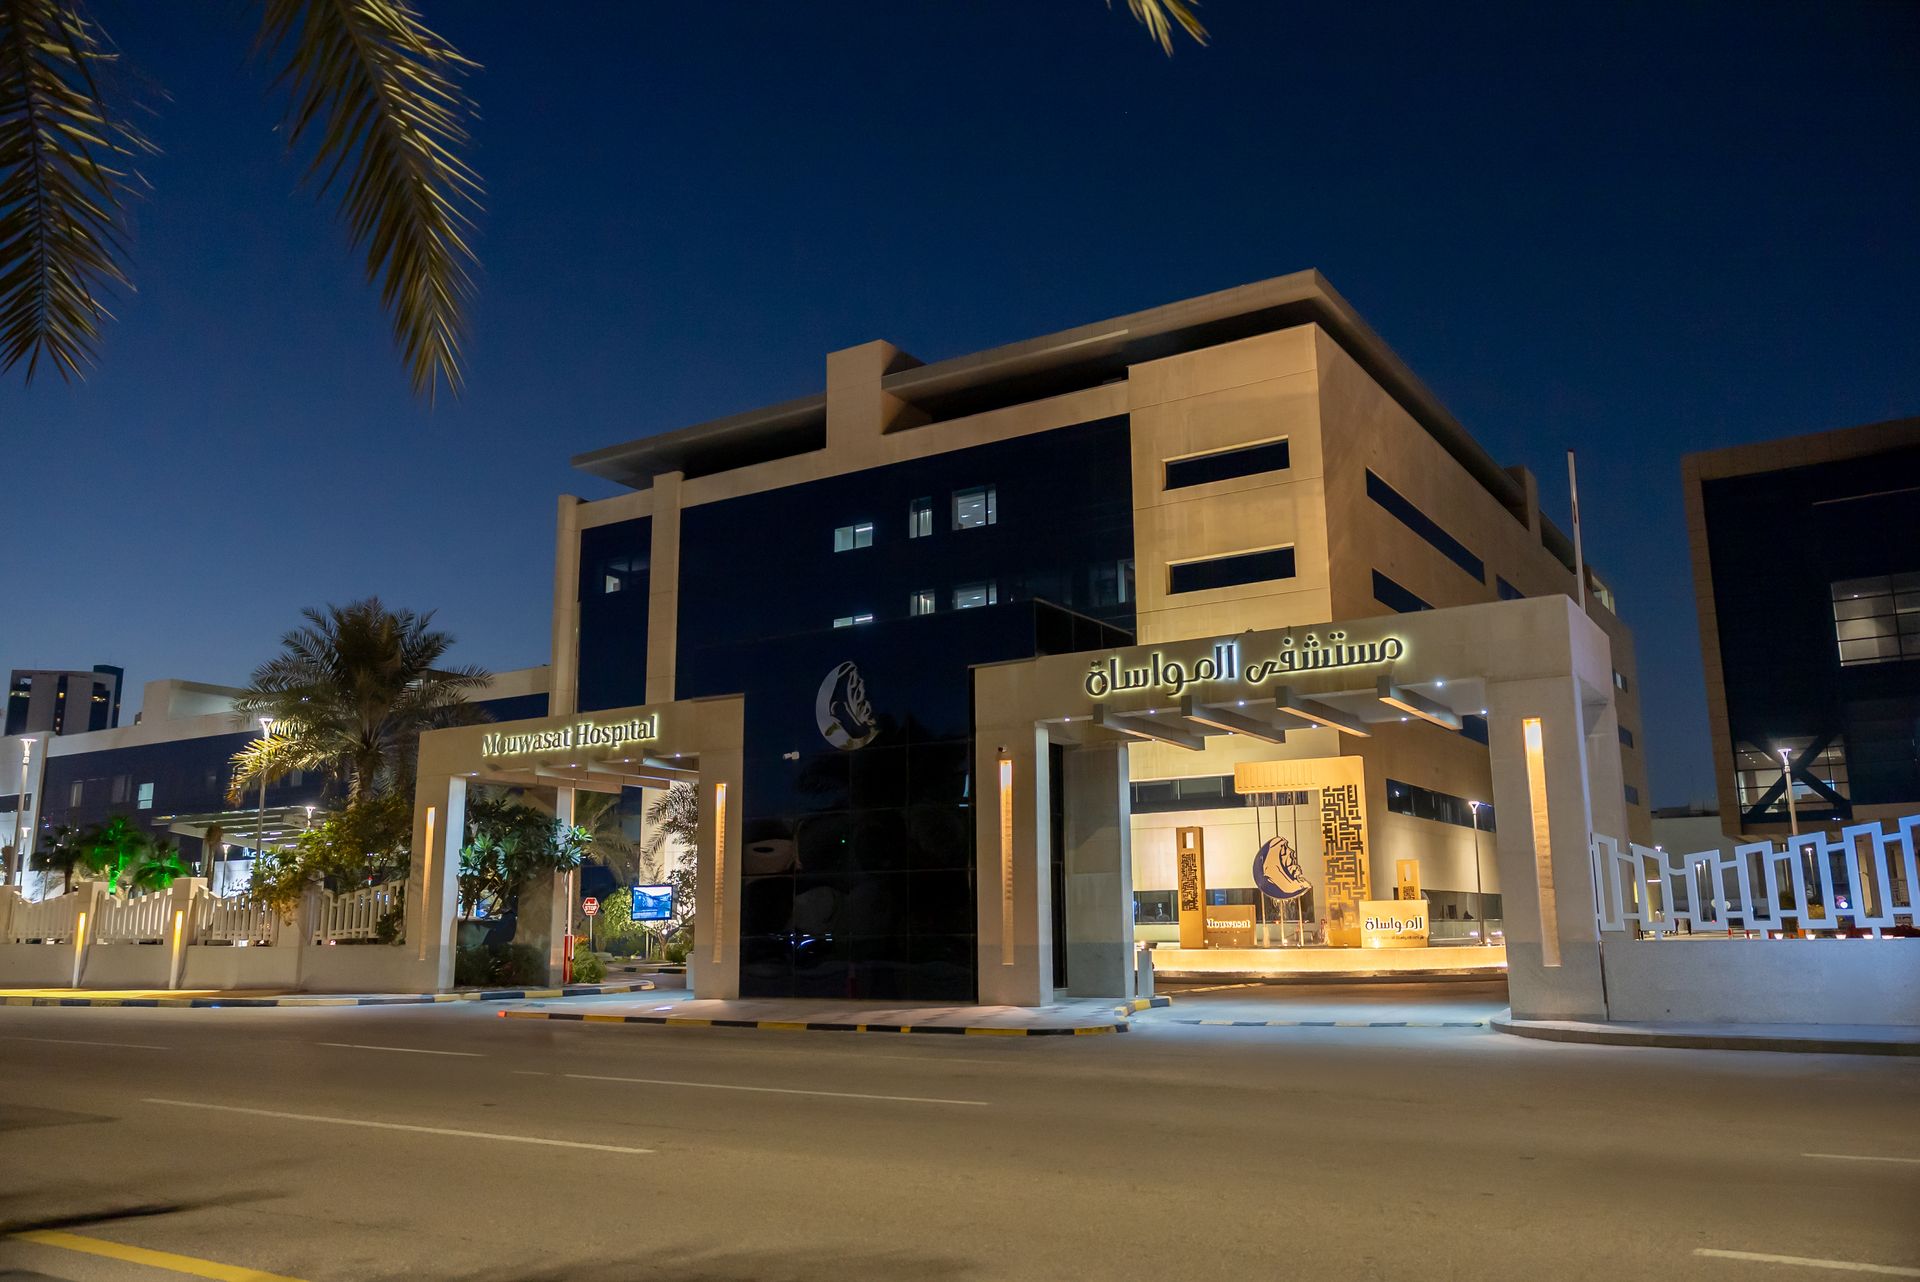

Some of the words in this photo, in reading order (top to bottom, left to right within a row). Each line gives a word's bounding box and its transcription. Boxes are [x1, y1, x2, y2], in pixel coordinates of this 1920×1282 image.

[1085, 644, 1236, 696] المواساة
[1245, 631, 1404, 684] مستشفى
[482, 730, 572, 756] Mouwasat
[576, 714, 657, 748] Hospital
[1365, 917, 1423, 932] المواساة
